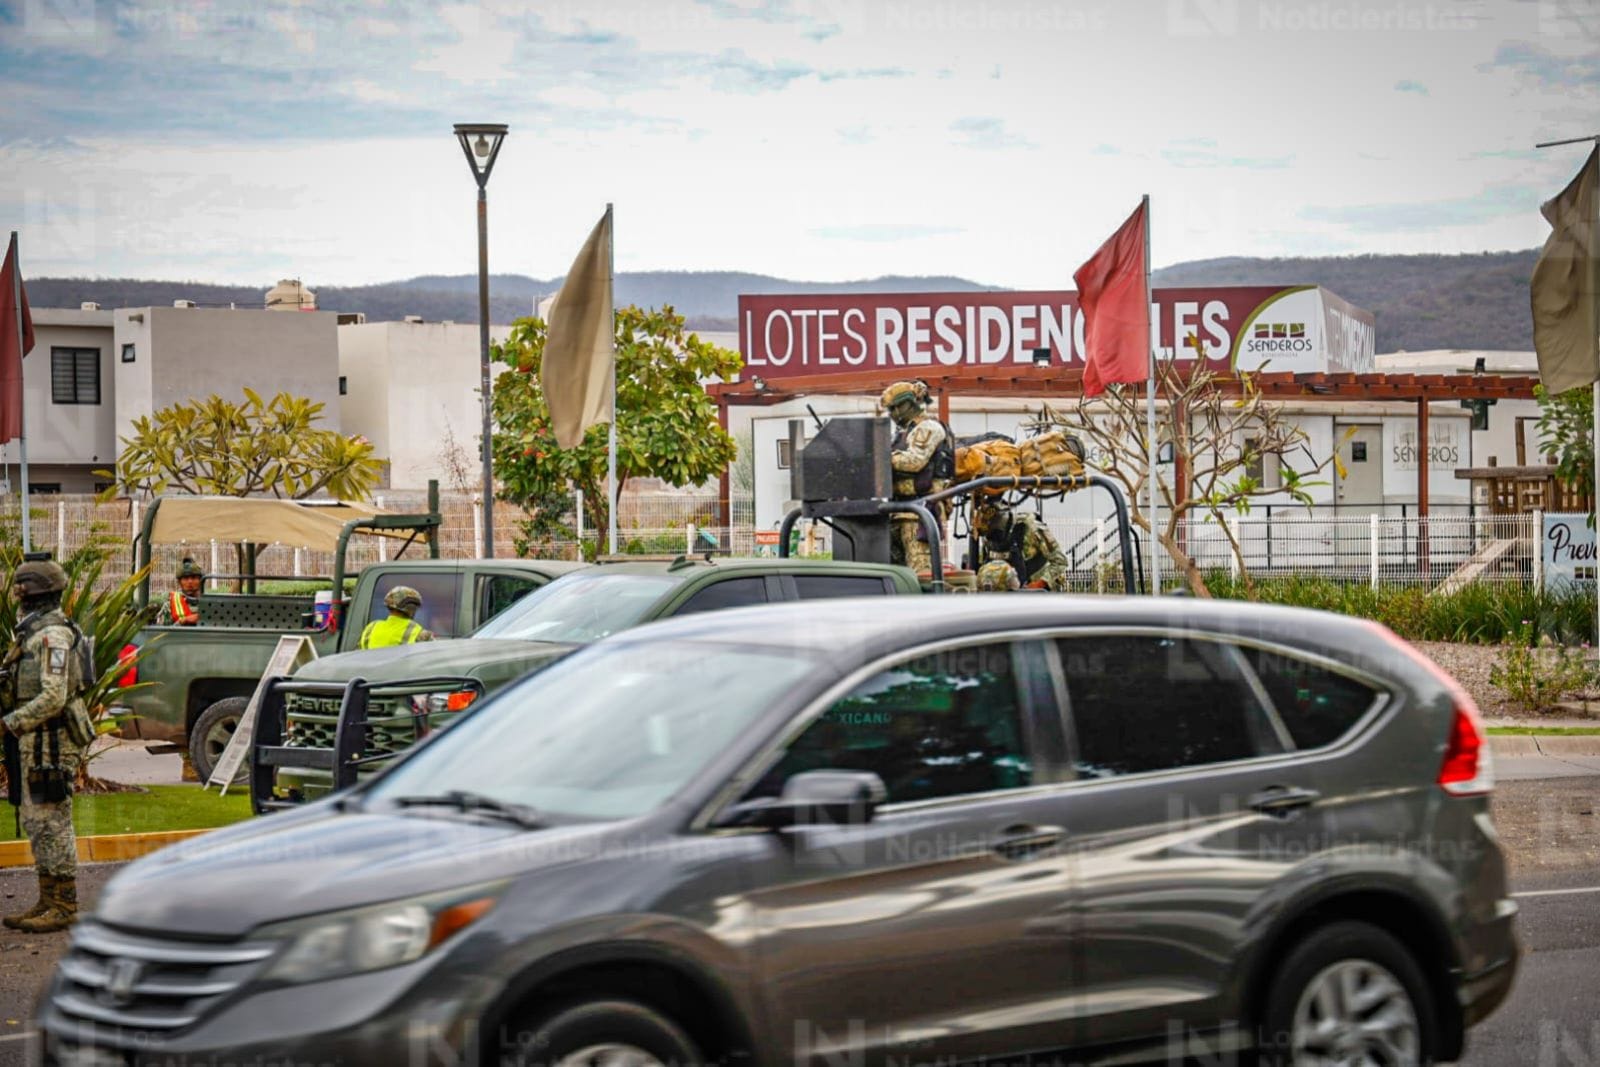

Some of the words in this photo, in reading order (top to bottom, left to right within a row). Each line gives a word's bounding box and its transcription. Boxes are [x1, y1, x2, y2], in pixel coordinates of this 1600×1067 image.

[746, 308, 867, 366] LOTES
[875, 300, 1231, 366] RESIDENLES
[1247, 338, 1313, 353] SENDEROS
[1392, 445, 1459, 463] SENEROS
[286, 694, 395, 713] CHEVRET
